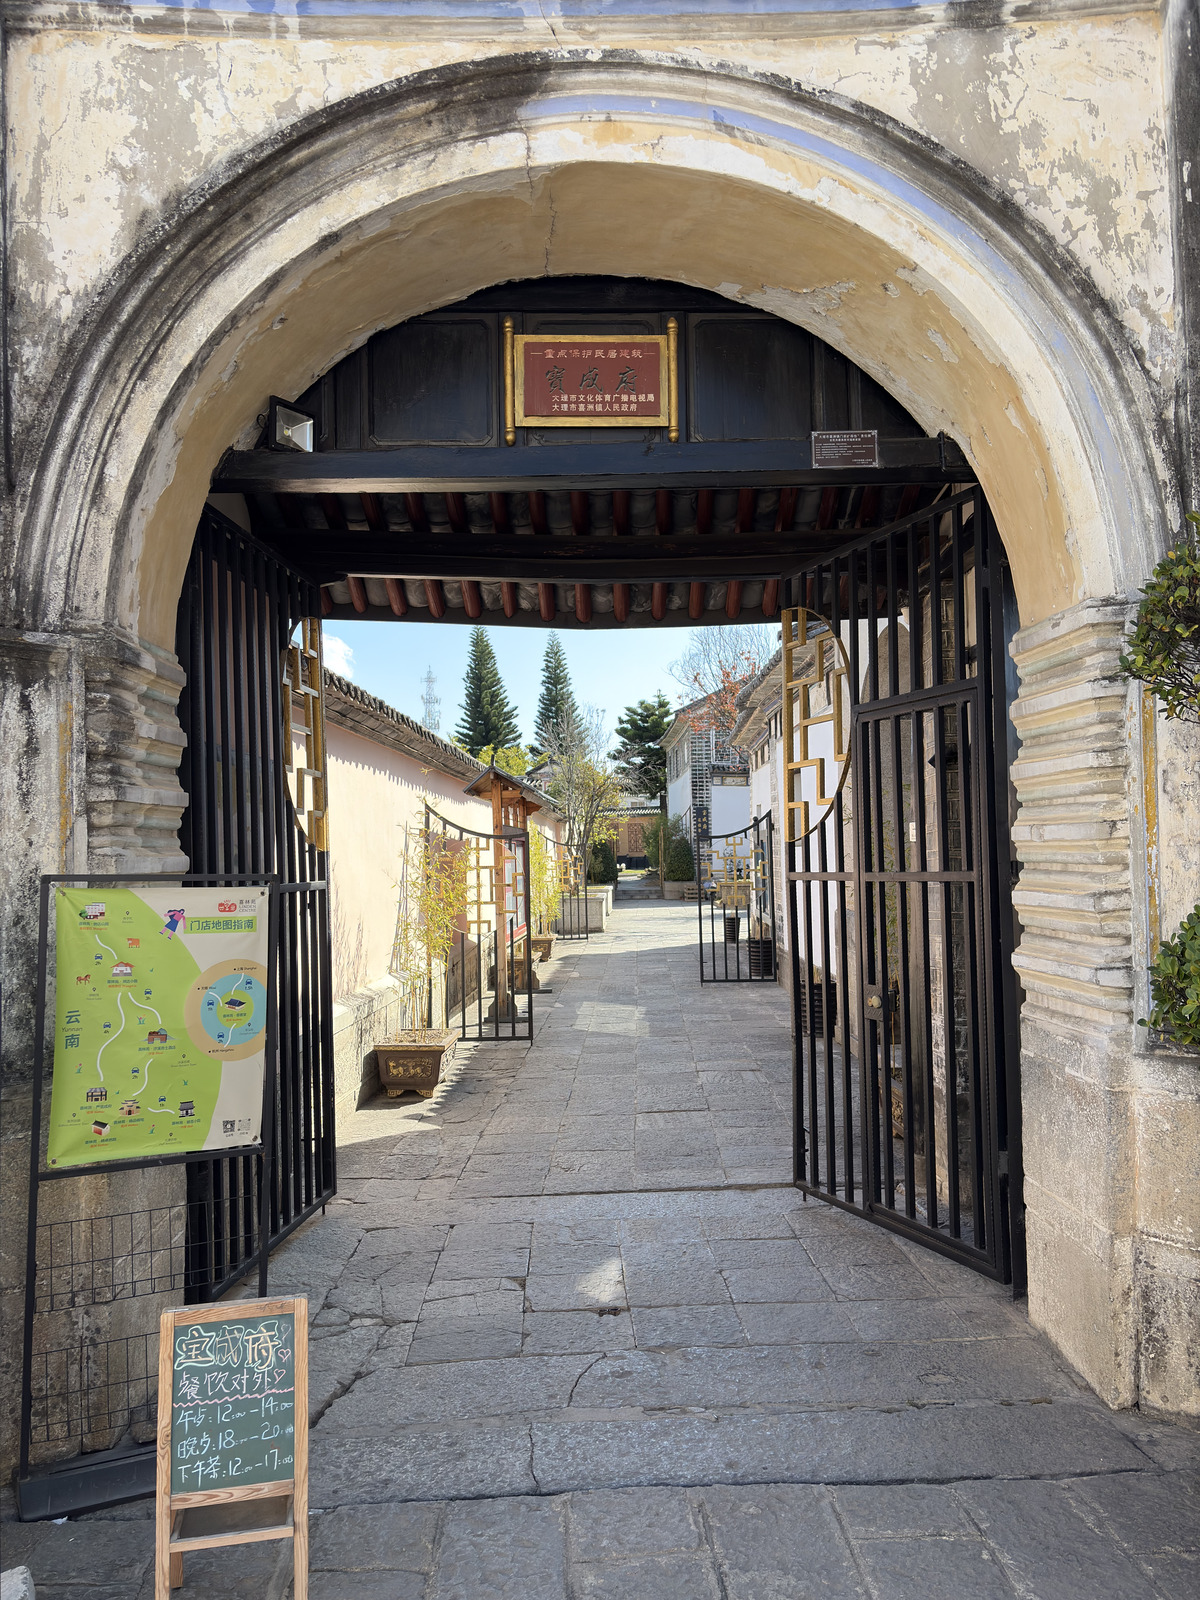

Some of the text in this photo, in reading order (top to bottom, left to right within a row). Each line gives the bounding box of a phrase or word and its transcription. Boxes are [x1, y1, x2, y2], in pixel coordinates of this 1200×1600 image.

[551, 393, 656, 402] 大理市文化体育广播电视局
[551, 403, 638, 412] 大理市喜洲镇人民政府
[190, 919, 254, 931] 门店地图指南
[178, 1326, 279, 1370] 宝成府
[178, 1368, 272, 1399] 餐饮对外
